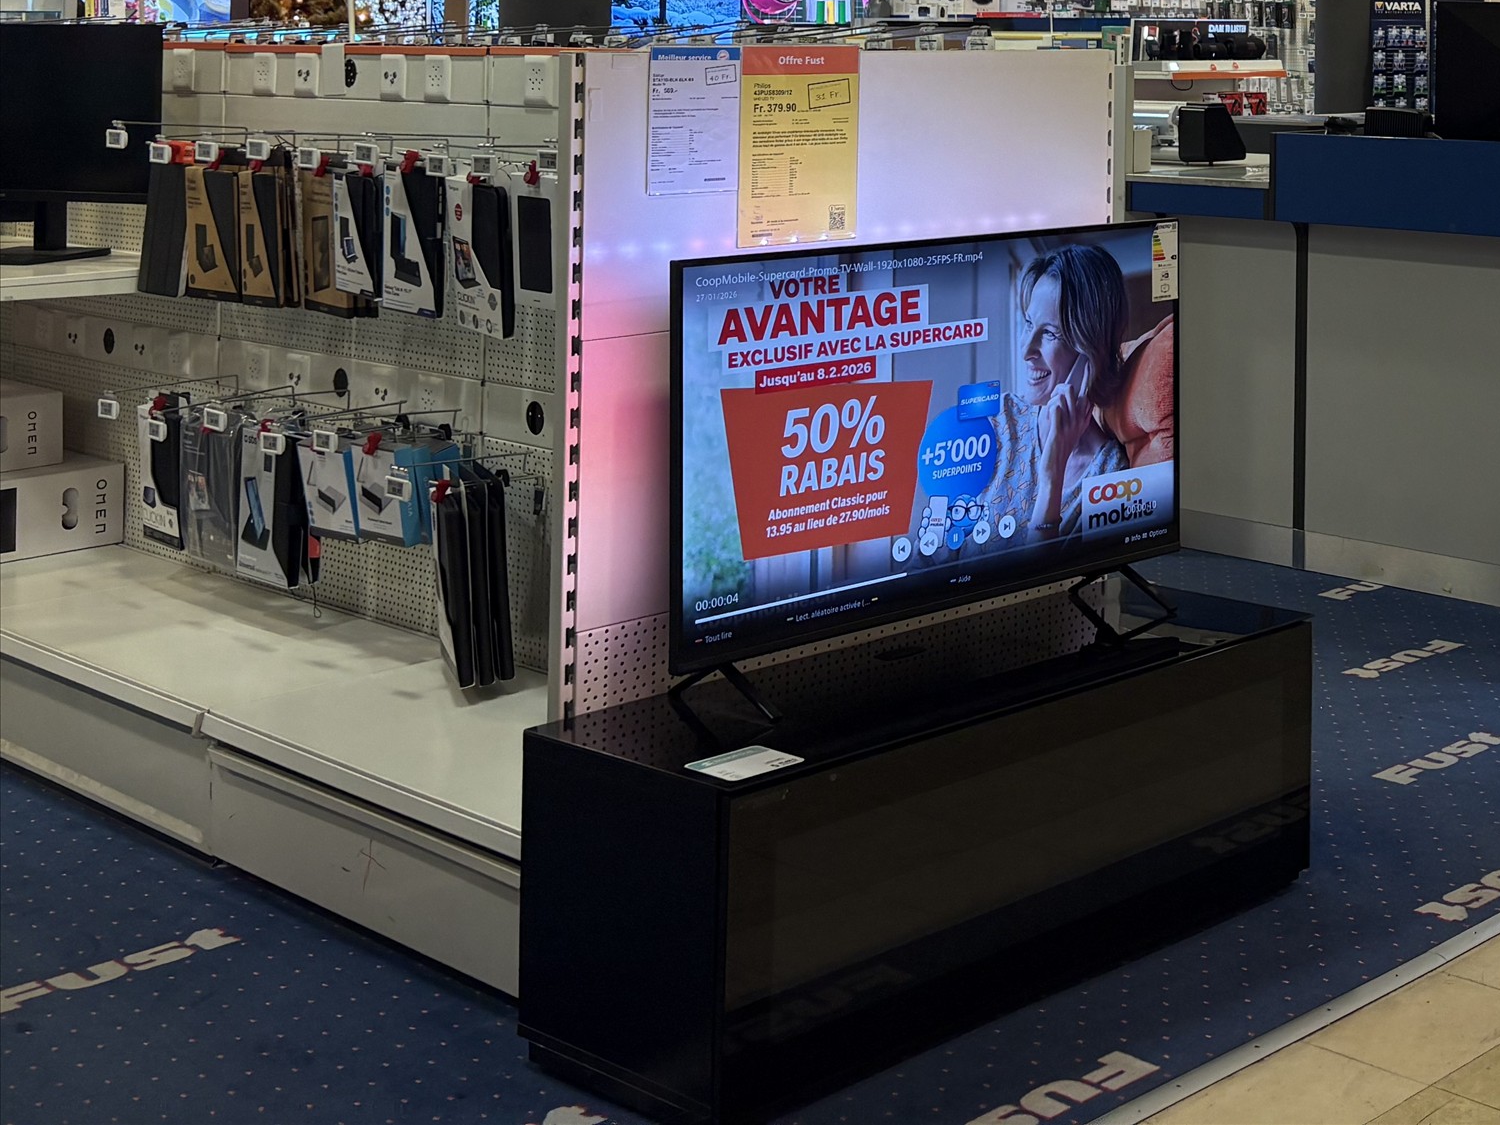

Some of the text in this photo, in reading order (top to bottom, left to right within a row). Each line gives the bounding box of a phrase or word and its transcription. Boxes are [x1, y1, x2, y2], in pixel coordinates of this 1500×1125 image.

[1384, 1, 1422, 11] VARTA
[778, 55, 825, 65] Offre Fust
[753, 103, 797, 113] Fr. 379.90
[695, 251, 984, 288] CoopMobile-Supercard-Promo-TV-Wall-1920x1080-25FPS-FR.mp4
[695, 291, 738, 303] 27/01/2026
[769, 274, 840, 300] VOTRE
[717, 289, 921, 346] AVANTAGE
[728, 322, 984, 369] EXCLUSIF AVEC LA SUPERCARD
[759, 361, 872, 389] Jusqu'au 8.2.2026
[961, 394, 999, 406] SUPERCARD
[27, 411, 37, 455] OMEN
[781, 395, 886, 458] 50%
[779, 449, 886, 497] RABAIS
[932, 462, 982, 480] SUPERPOINTS
[768, 490, 888, 521] Abonnement Classic pour
[1088, 478, 1142, 505] coop
[95, 479, 108, 535] OMEN
[766, 505, 890, 538] 13.95 au lieu de 27.90/mois
[695, 592, 739, 612] 00:00:04
